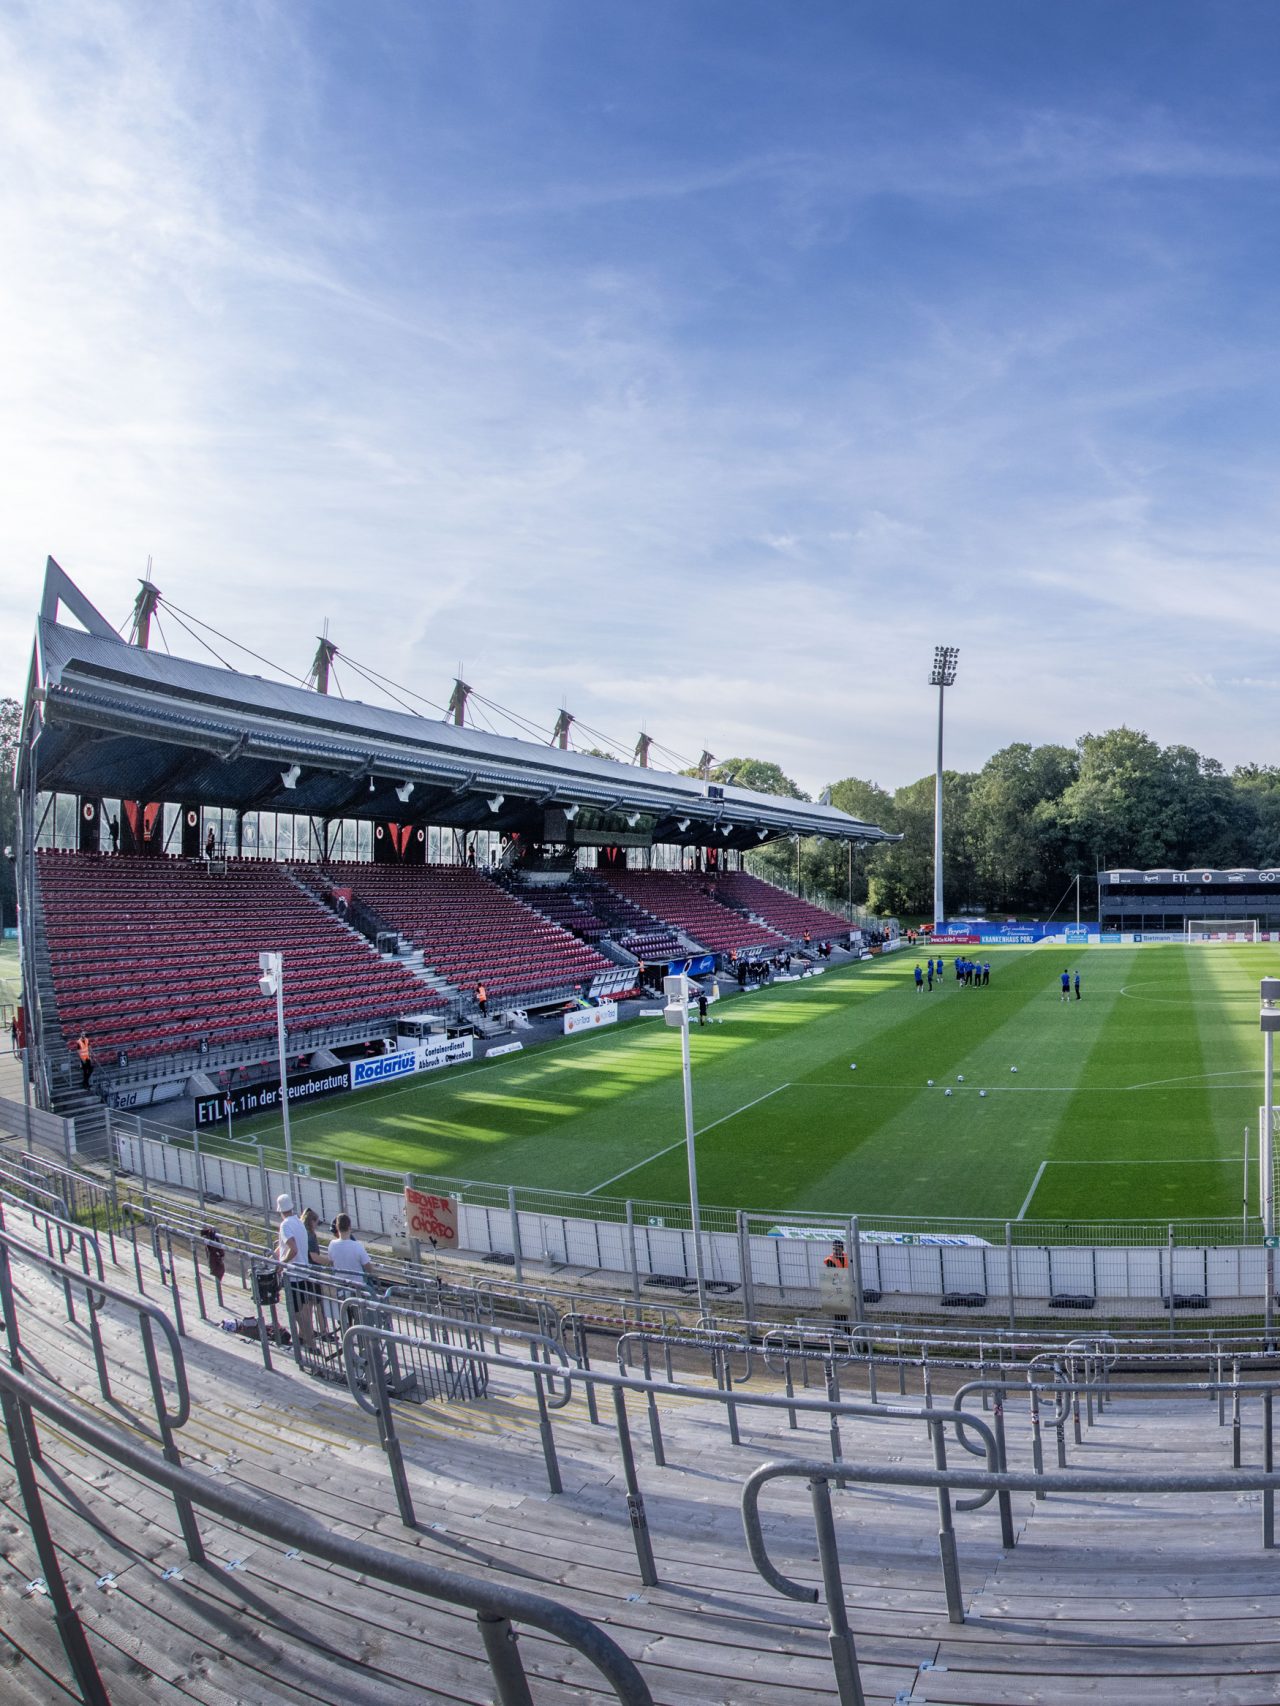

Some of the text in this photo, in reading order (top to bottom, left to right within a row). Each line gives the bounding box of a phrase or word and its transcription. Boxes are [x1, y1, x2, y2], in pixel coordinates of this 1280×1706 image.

[1172, 873, 1190, 883] ETL
[1258, 872, 1276, 882] GO
[981, 935, 1019, 943] KRANKENHAUS
[1020, 935, 1034, 943] PORZ
[424, 1040, 465, 1057] Containerdienst
[355, 1054, 416, 1082] Rodarius
[418, 1056, 440, 1070] Abbruch
[198, 1099, 222, 1123] ETL
[223, 1099, 239, 1116] Nr.
[247, 1093, 257, 1109] in
[260, 1089, 277, 1105] der
